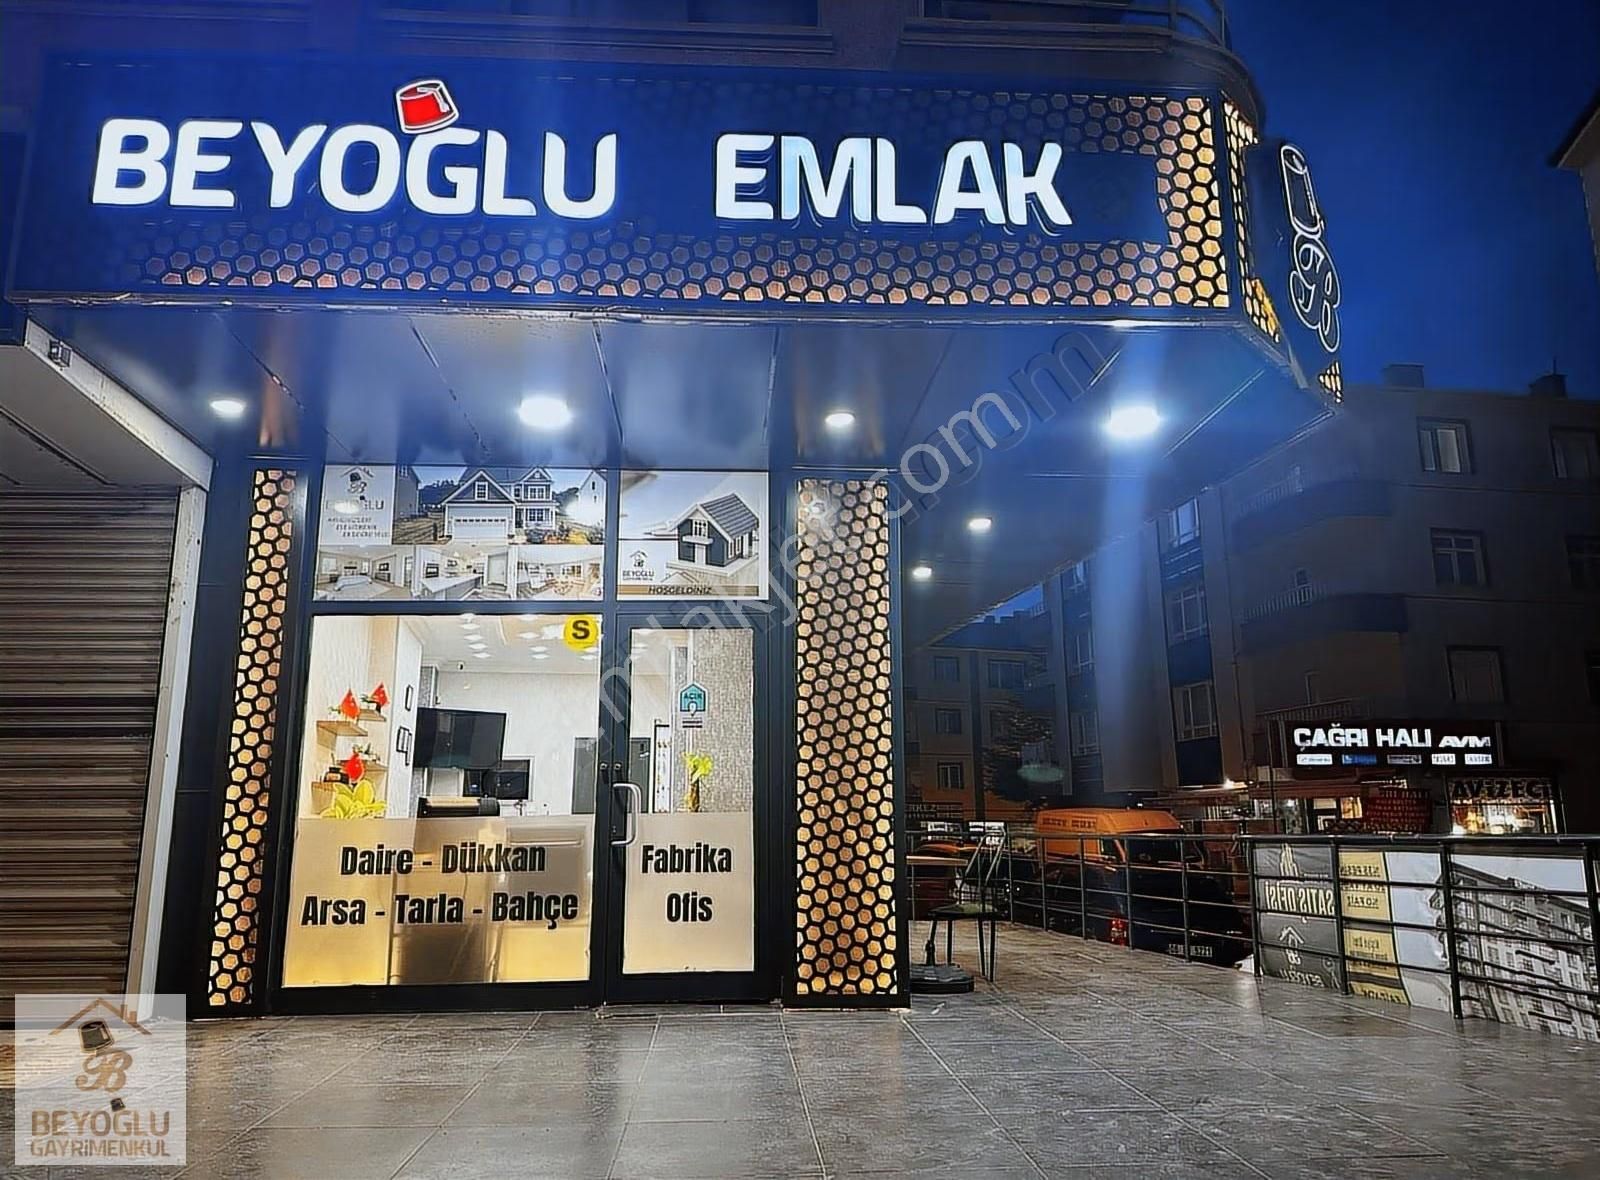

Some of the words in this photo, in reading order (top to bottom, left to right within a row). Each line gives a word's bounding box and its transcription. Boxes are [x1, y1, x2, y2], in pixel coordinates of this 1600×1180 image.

[715, 133, 1073, 226] EMLAK
[572, 620, 591, 640] S
[1293, 722, 1369, 751] ÇAĞRI
[1376, 728, 1433, 748] HALI
[1438, 735, 1492, 748] AVM
[340, 844, 414, 876] Daire
[441, 843, 546, 874] Dükkan
[641, 844, 732, 874] Fabrika
[301, 895, 367, 926] Arsa
[393, 893, 464, 924] Tarla
[491, 891, 579, 930] Bahçe
[665, 892, 713, 923] Ofis
